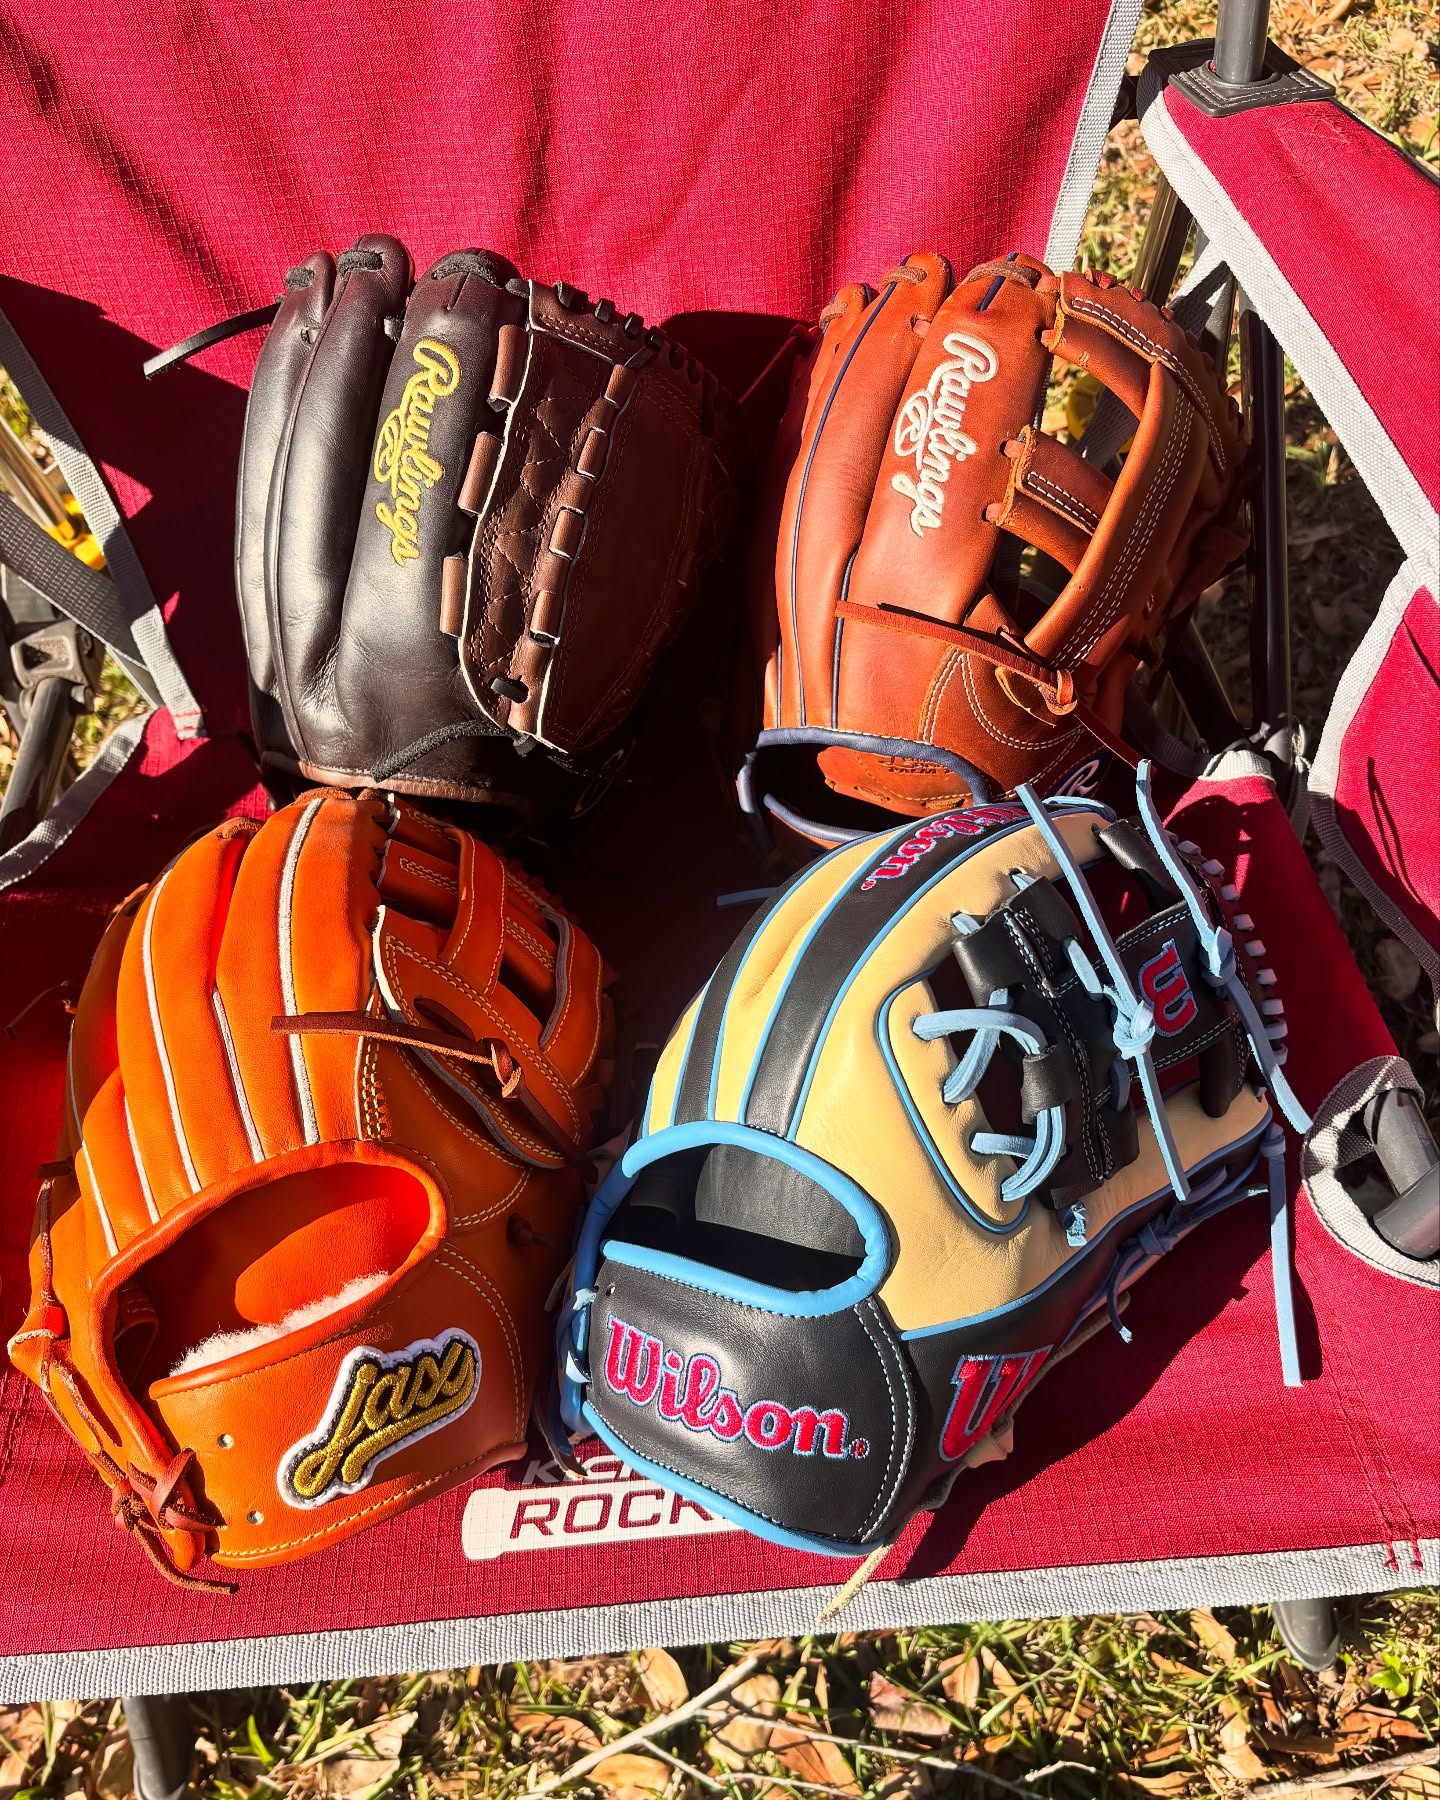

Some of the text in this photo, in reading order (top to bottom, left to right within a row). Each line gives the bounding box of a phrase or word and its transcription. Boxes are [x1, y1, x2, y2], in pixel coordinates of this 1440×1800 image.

[374, 338, 461, 568] Rawlings
[891, 332, 998, 538] Rawlings
[604, 1313, 850, 1460] Wilson
[510, 1488, 727, 1540] ROCK
